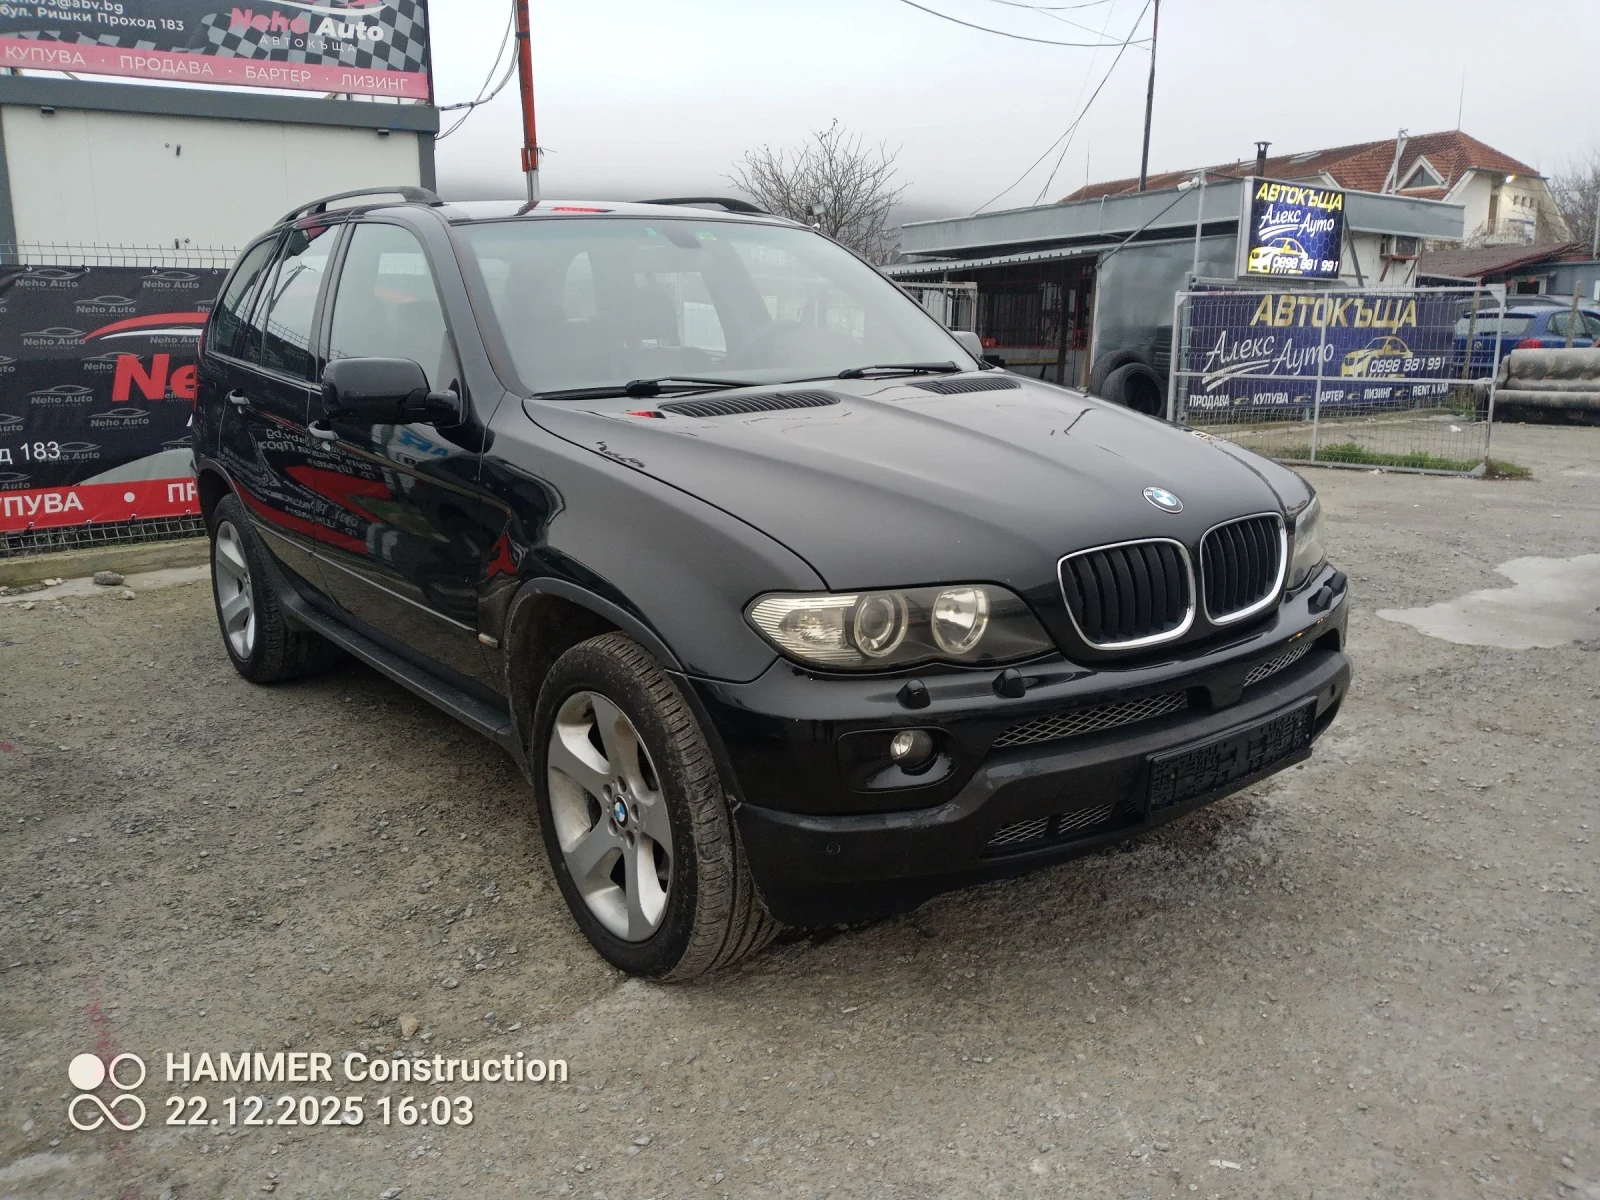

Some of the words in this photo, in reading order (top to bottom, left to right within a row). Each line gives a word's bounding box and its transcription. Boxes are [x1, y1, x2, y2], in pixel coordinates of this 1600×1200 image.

[0, 4, 33, 18] бул.
[37, 7, 92, 22] Ришки
[97, 12, 157, 30] Проход
[160, 18, 185, 32] 183
[229, 7, 309, 34] Neho
[314, 17, 385, 42] Auto
[258, 35, 357, 53] АВТОКЪЩА
[5, 45, 86, 66] КУПУВА
[119, 55, 214, 76] ПРОДАВА
[245, 66, 311, 83] БАРТЕР
[340, 73, 408, 91] ЛИЗИНГ
[1255, 182, 1343, 213] АВТОКЪЩА
[1258, 203, 1302, 229] Алекс
[1296, 212, 1335, 238] Ауто
[1272, 256, 1299, 269] 0898
[1300, 258, 1319, 271] 881
[1320, 259, 1339, 272] 991
[15, 279, 47, 287] Neho
[50, 279, 79, 288] Auto
[142, 280, 171, 289] Neho
[173, 281, 200, 289] Auto
[76, 305, 106, 313] Neho
[1249, 293, 1417, 335] АВТОКЪЩА
[23, 338, 55, 346] Neho
[149, 336, 178, 344] Neho
[1202, 330, 1275, 373] Алекс
[83, 362, 114, 371] Neho
[1369, 359, 1401, 373] 0898
[1403, 359, 1426, 372] 881
[1427, 357, 1446, 371] 991
[1189, 394, 1230, 410] ПРОДАВА
[1253, 392, 1289, 406] КУПУВА
[1319, 389, 1345, 403] АРТЕР
[1363, 387, 1393, 400] ЛИЗИНГ
[1412, 384, 1431, 397] RENT
[30, 396, 62, 405] Neho
[64, 395, 93, 403] Auto
[90, 419, 120, 427] Neho
[122, 418, 150, 426] Auto
[20, 441, 61, 461] 183
[72, 452, 100, 460] Auto
[2, 482, 31, 490] Auto
